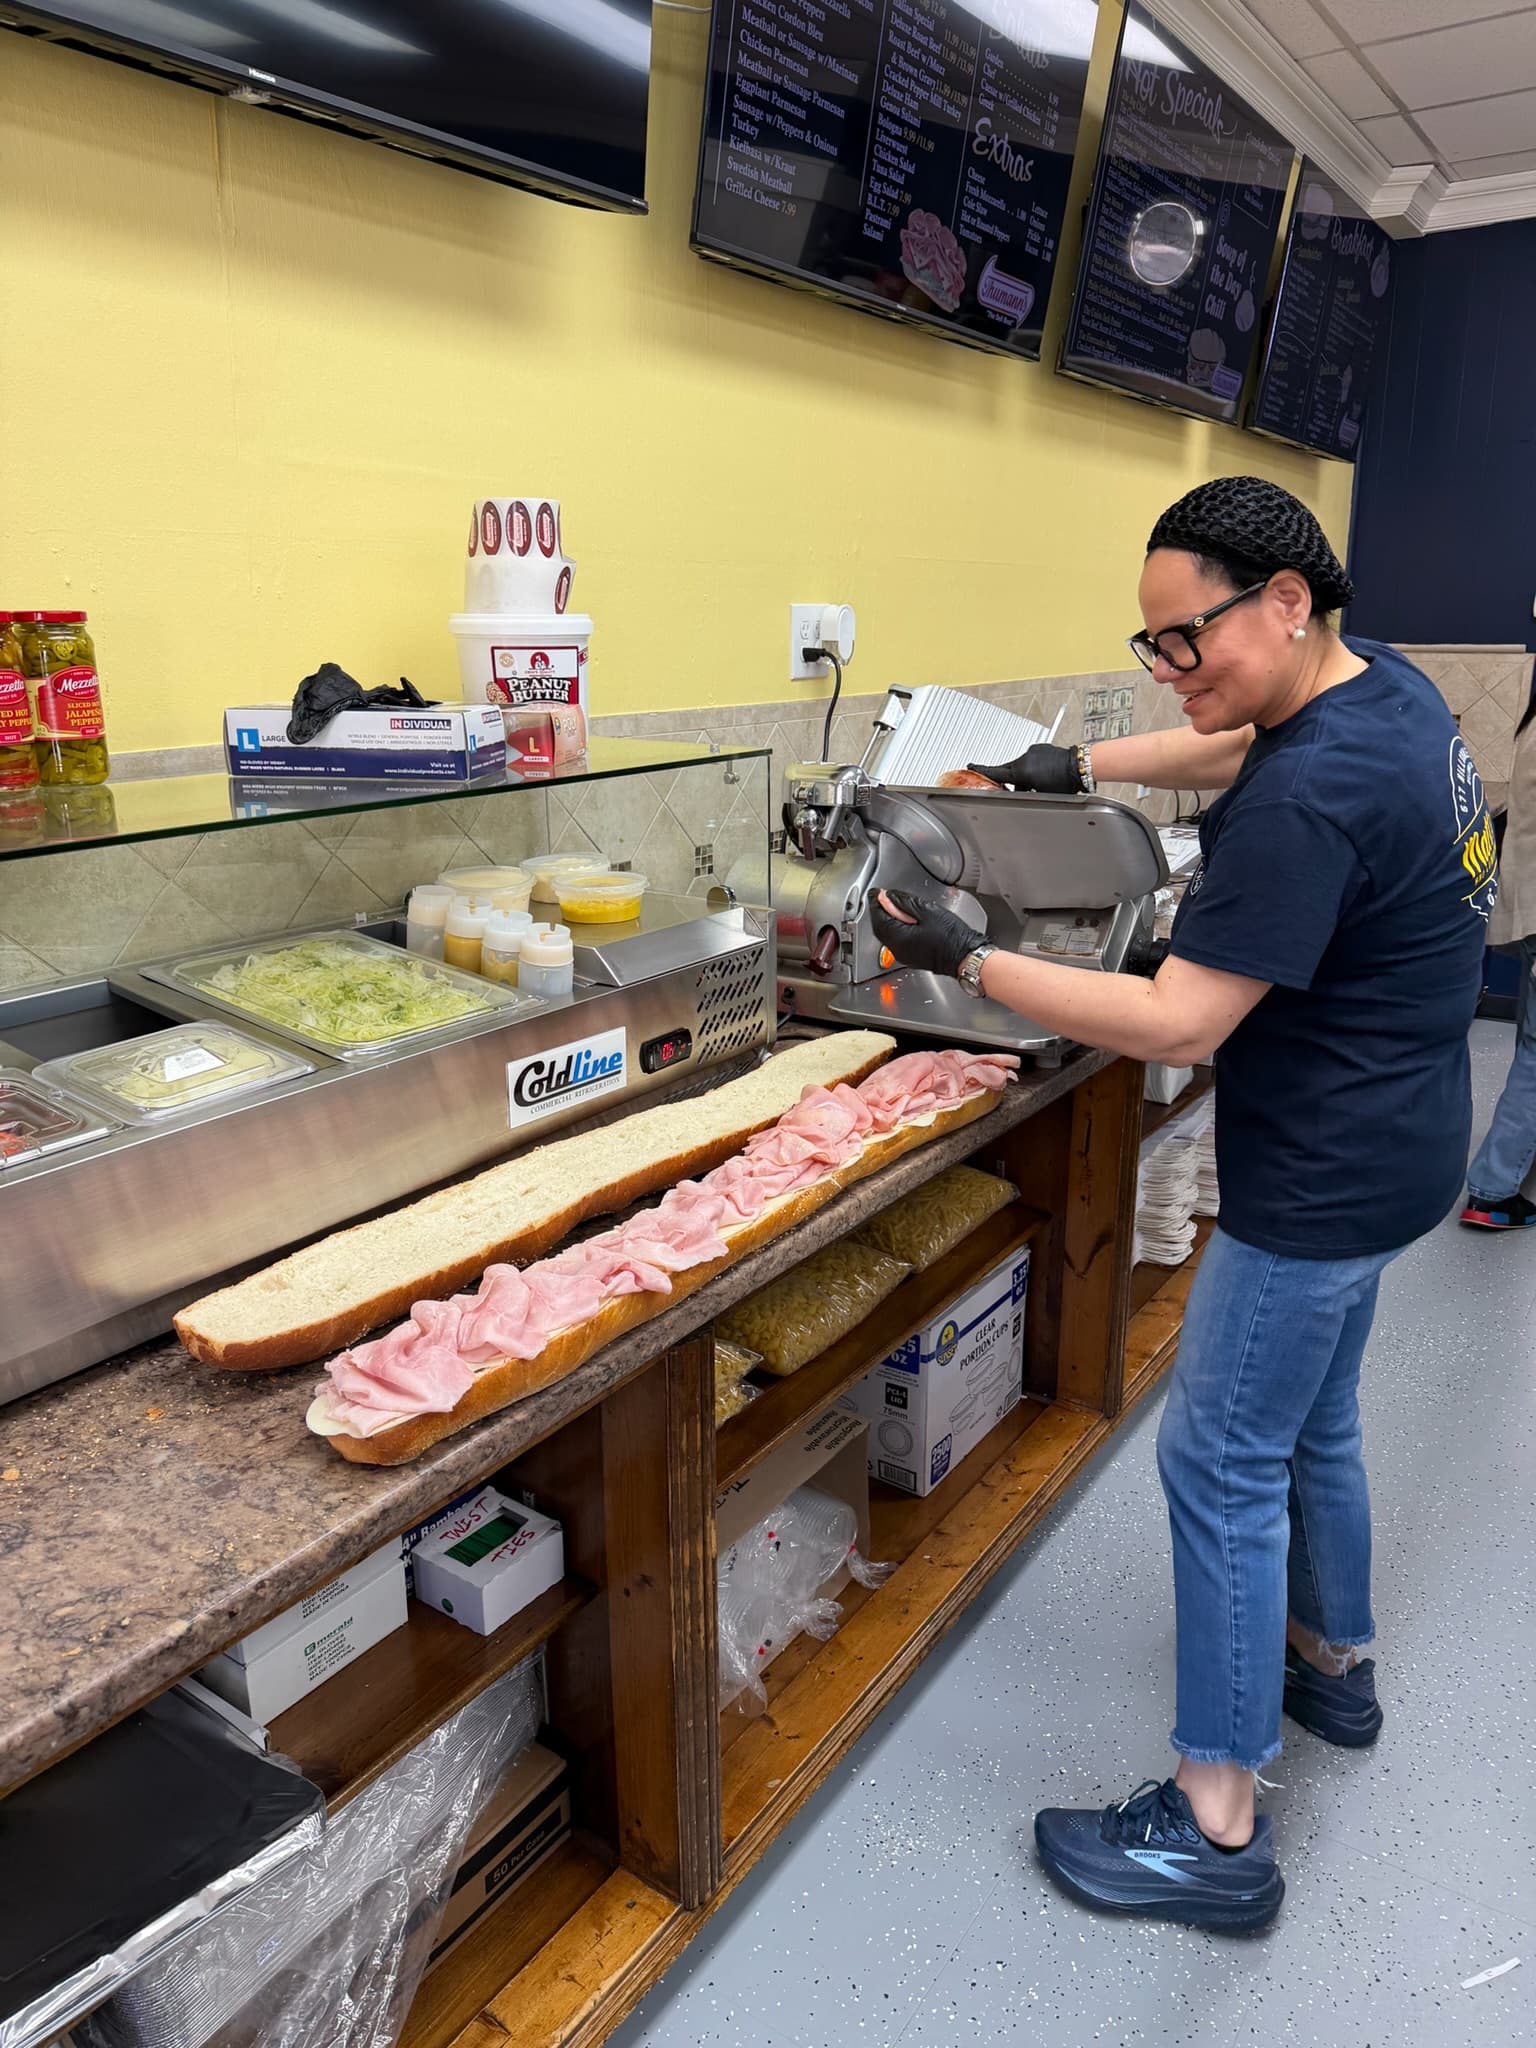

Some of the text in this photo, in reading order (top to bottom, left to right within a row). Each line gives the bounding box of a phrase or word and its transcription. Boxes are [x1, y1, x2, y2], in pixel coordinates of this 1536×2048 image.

[742, 4, 777, 38] Meatball
[778, 29, 787, 41] or
[787, 34, 816, 61] Sausage
[778, 4, 806, 33] Cordon
[891, 12, 912, 35] Deluxe
[912, 26, 929, 46] Roast
[929, 37, 942, 55] Beef
[914, 8, 935, 31] Special
[740, 28, 809, 78] Chicken Parmesan
[889, 30, 905, 51] Roast
[907, 43, 920, 60] Beef
[738, 49, 846, 119] Meatball or Sausage Parmesan
[891, 51, 897, 65] &
[898, 56, 918, 78] Brown
[919, 69, 936, 92] Gravy
[735, 71, 807, 120] Eggplant Parmesan
[882, 80, 919, 111] Deluxe Ham
[884, 64, 909, 88] Cracked
[910, 80, 930, 101] Pepper
[943, 99, 961, 123] Turkey
[1161, 70, 1238, 145] Specials
[732, 113, 759, 140] Turkey
[733, 94, 838, 156] Sausage w/Peppers & Onions
[878, 112, 902, 137] Bologna
[903, 127, 916, 144] 9.99
[880, 96, 921, 129] Genoa Salami
[729, 134, 797, 176] Kielbasa w/Kraut
[876, 127, 908, 155] Liverwurst
[972, 117, 1034, 182] Extras
[727, 156, 793, 195] Swedish Meatball
[872, 158, 905, 185] Tuna Salad
[874, 143, 916, 175] Chicken Salad
[967, 166, 987, 185] Cheese
[725, 177, 797, 216] Grilled Cheese 7.99
[870, 176, 881, 194] Egg
[882, 183, 899, 200] Salad
[863, 223, 885, 242] Salami
[865, 208, 892, 231] Pastrami
[1216, 234, 1248, 273] Soup of
[1331, 214, 1375, 268] Breakfast
[1210, 264, 1242, 302] the Day
[1205, 294, 1227, 321] Chili
[507, 677, 571, 692] PEANUT
[512, 689, 569, 703] BUTTER
[242, 732, 256, 750] L
[391, 719, 451, 730] INDIVIDUAL
[528, 736, 541, 753] L
[514, 1049, 624, 1107] Coldline
[530, 1077, 621, 1114] COMMERCIAL REFRIGERATION
[960, 1335, 992, 1371] PORTION
[992, 1320, 1010, 1345] CUPS
[975, 1317, 996, 1344] CLEAR
[882, 1406, 909, 1422] 75mm
[439, 1496, 488, 1541] TWIST
[491, 1529, 536, 1562] TIES
[303, 1603, 322, 1619] MADE
[322, 1597, 330, 1606] IN
[330, 1584, 350, 1601] CHINA
[304, 1616, 354, 1656] Emerald
[318, 1633, 345, 1653] GLOVES
[309, 1665, 328, 1682] MADE
[336, 1645, 356, 1662] CHINA
[493, 1830, 546, 1883] 50 Per Case
[1134, 1851, 1161, 1860] BROOKS
